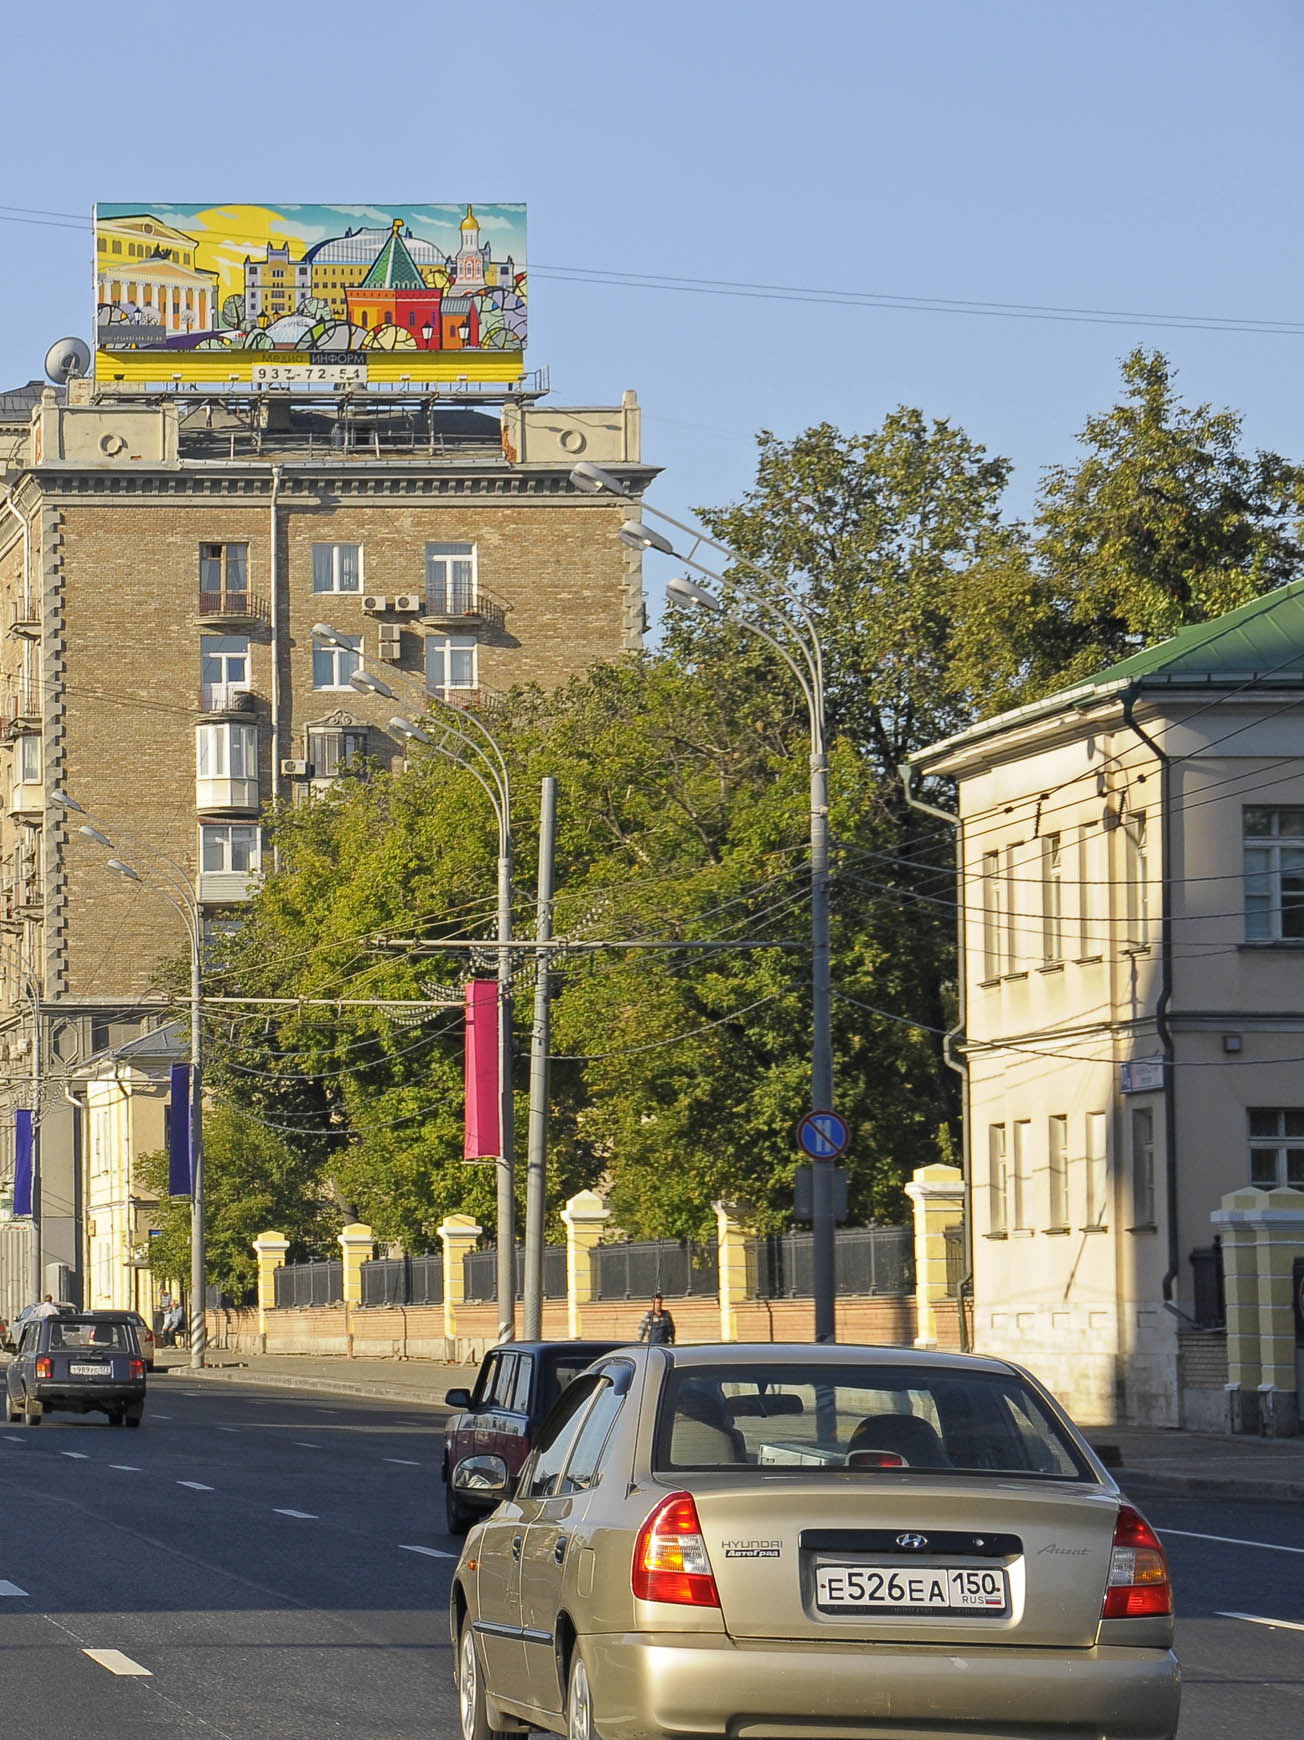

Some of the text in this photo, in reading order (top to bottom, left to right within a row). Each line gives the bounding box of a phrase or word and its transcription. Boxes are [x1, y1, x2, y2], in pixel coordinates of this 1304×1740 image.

[311, 353, 365, 364] ИНФОРМ
[721, 1540, 783, 1548] HYUNDAI
[727, 1549, 779, 1558] АвтоГрад
[951, 1573, 997, 1595] 150
[962, 1595, 985, 1605] RUS
